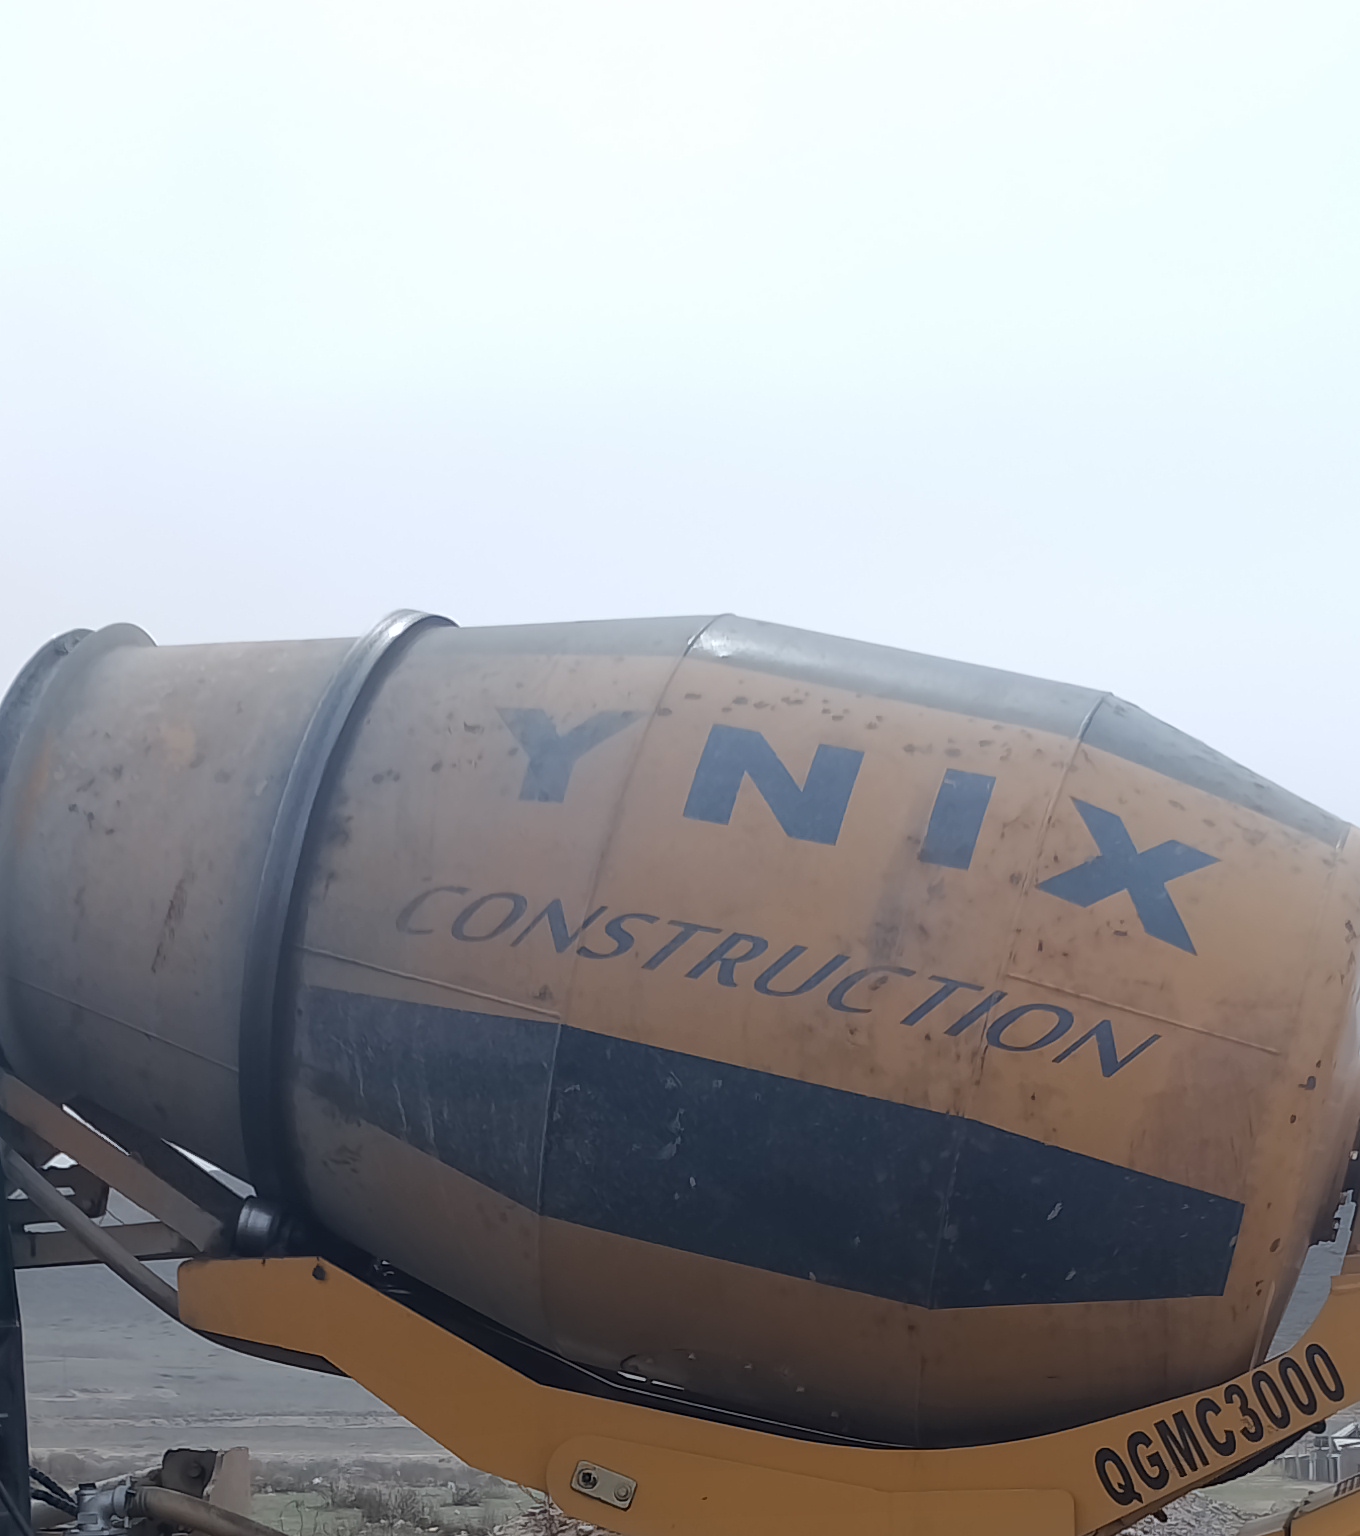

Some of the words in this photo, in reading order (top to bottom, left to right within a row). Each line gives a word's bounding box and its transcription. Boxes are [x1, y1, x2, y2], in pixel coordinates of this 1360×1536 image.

[497, 706, 1221, 955] YNIX
[394, 886, 1162, 1079] CONSTRUCTION
[1095, 1343, 1344, 1505] QGMC3000
